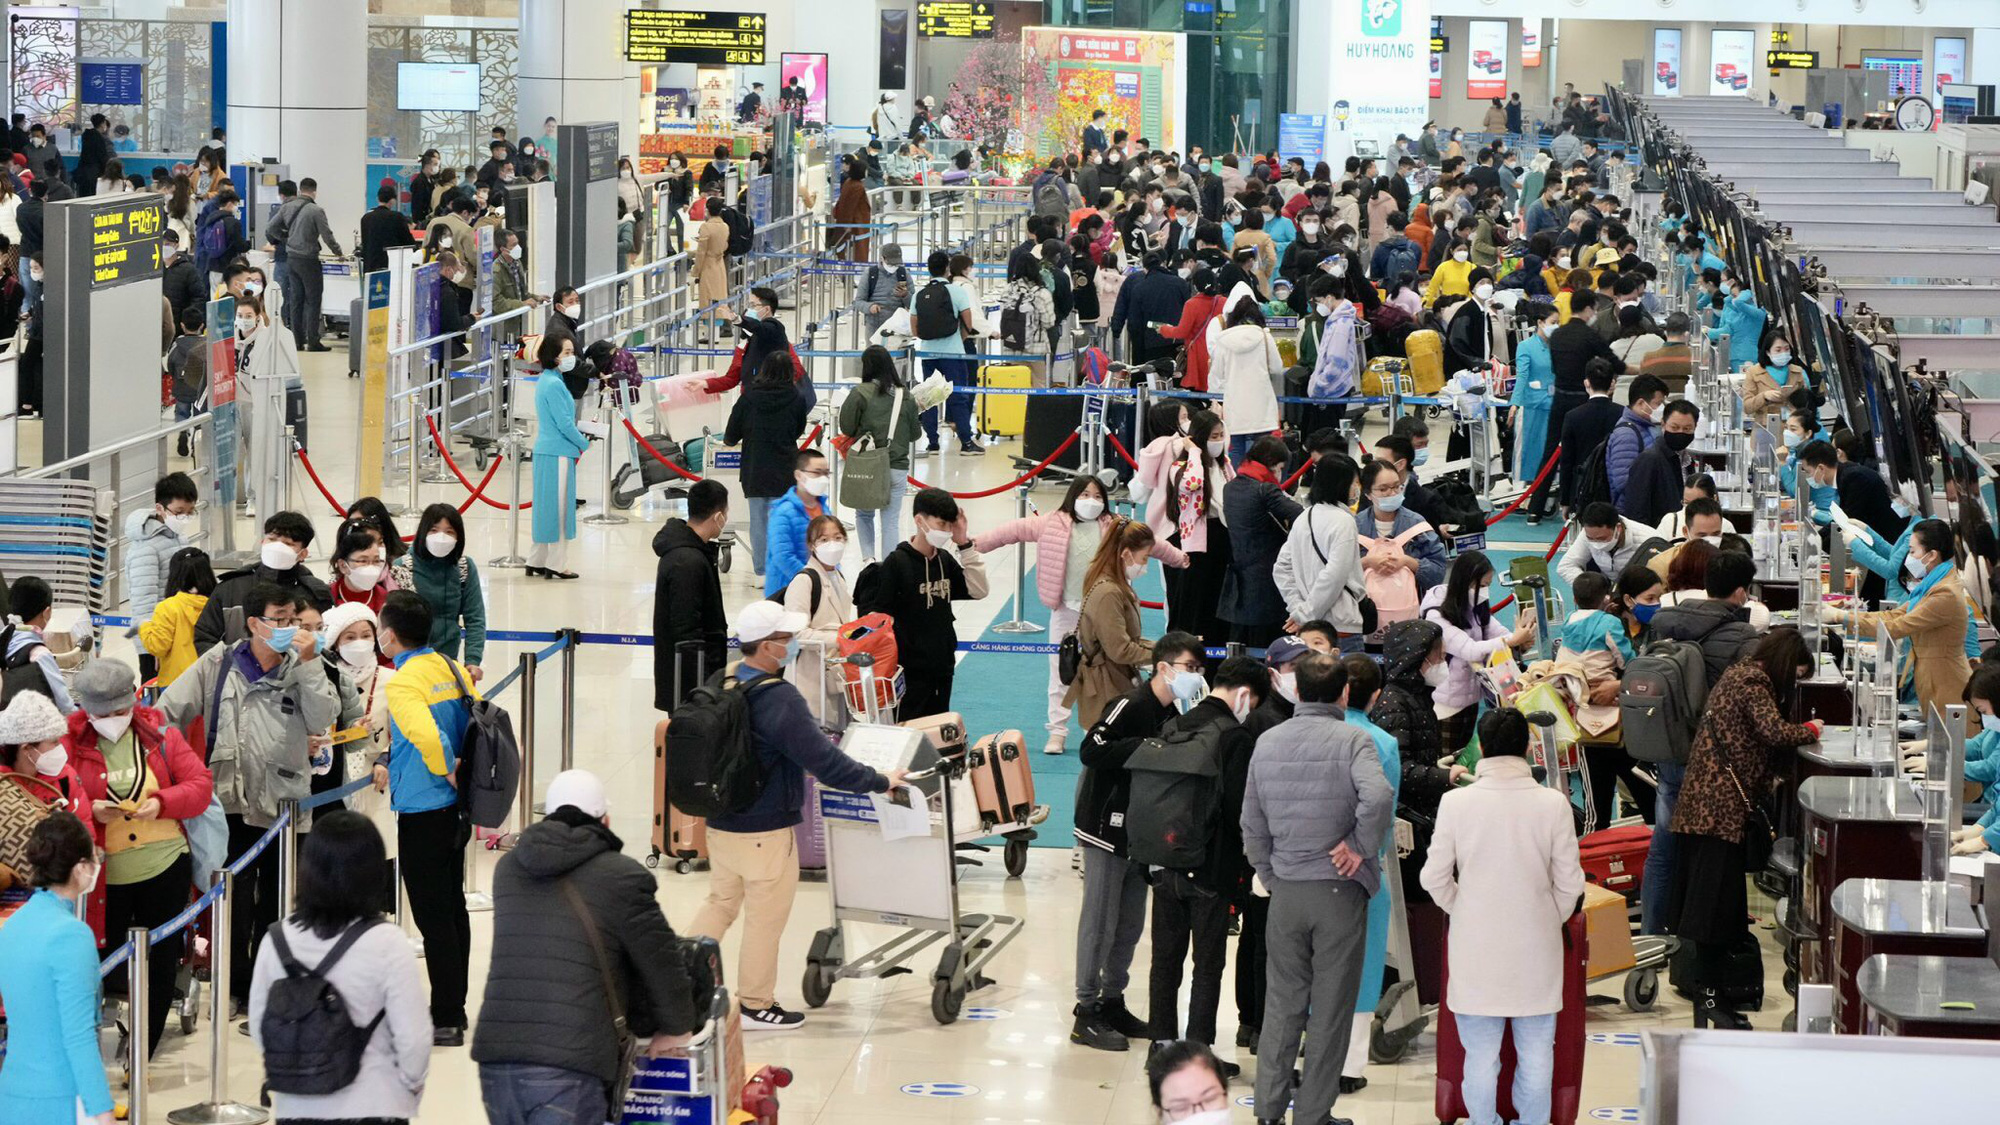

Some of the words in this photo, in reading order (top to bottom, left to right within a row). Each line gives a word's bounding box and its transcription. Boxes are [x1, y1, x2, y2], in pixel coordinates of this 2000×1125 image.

[646, 1070, 665, 1078] CUỘC
[634, 1096, 664, 1104] NANO
[624, 1104, 644, 1114] BẢO
[645, 1105, 658, 1117] VỆ
